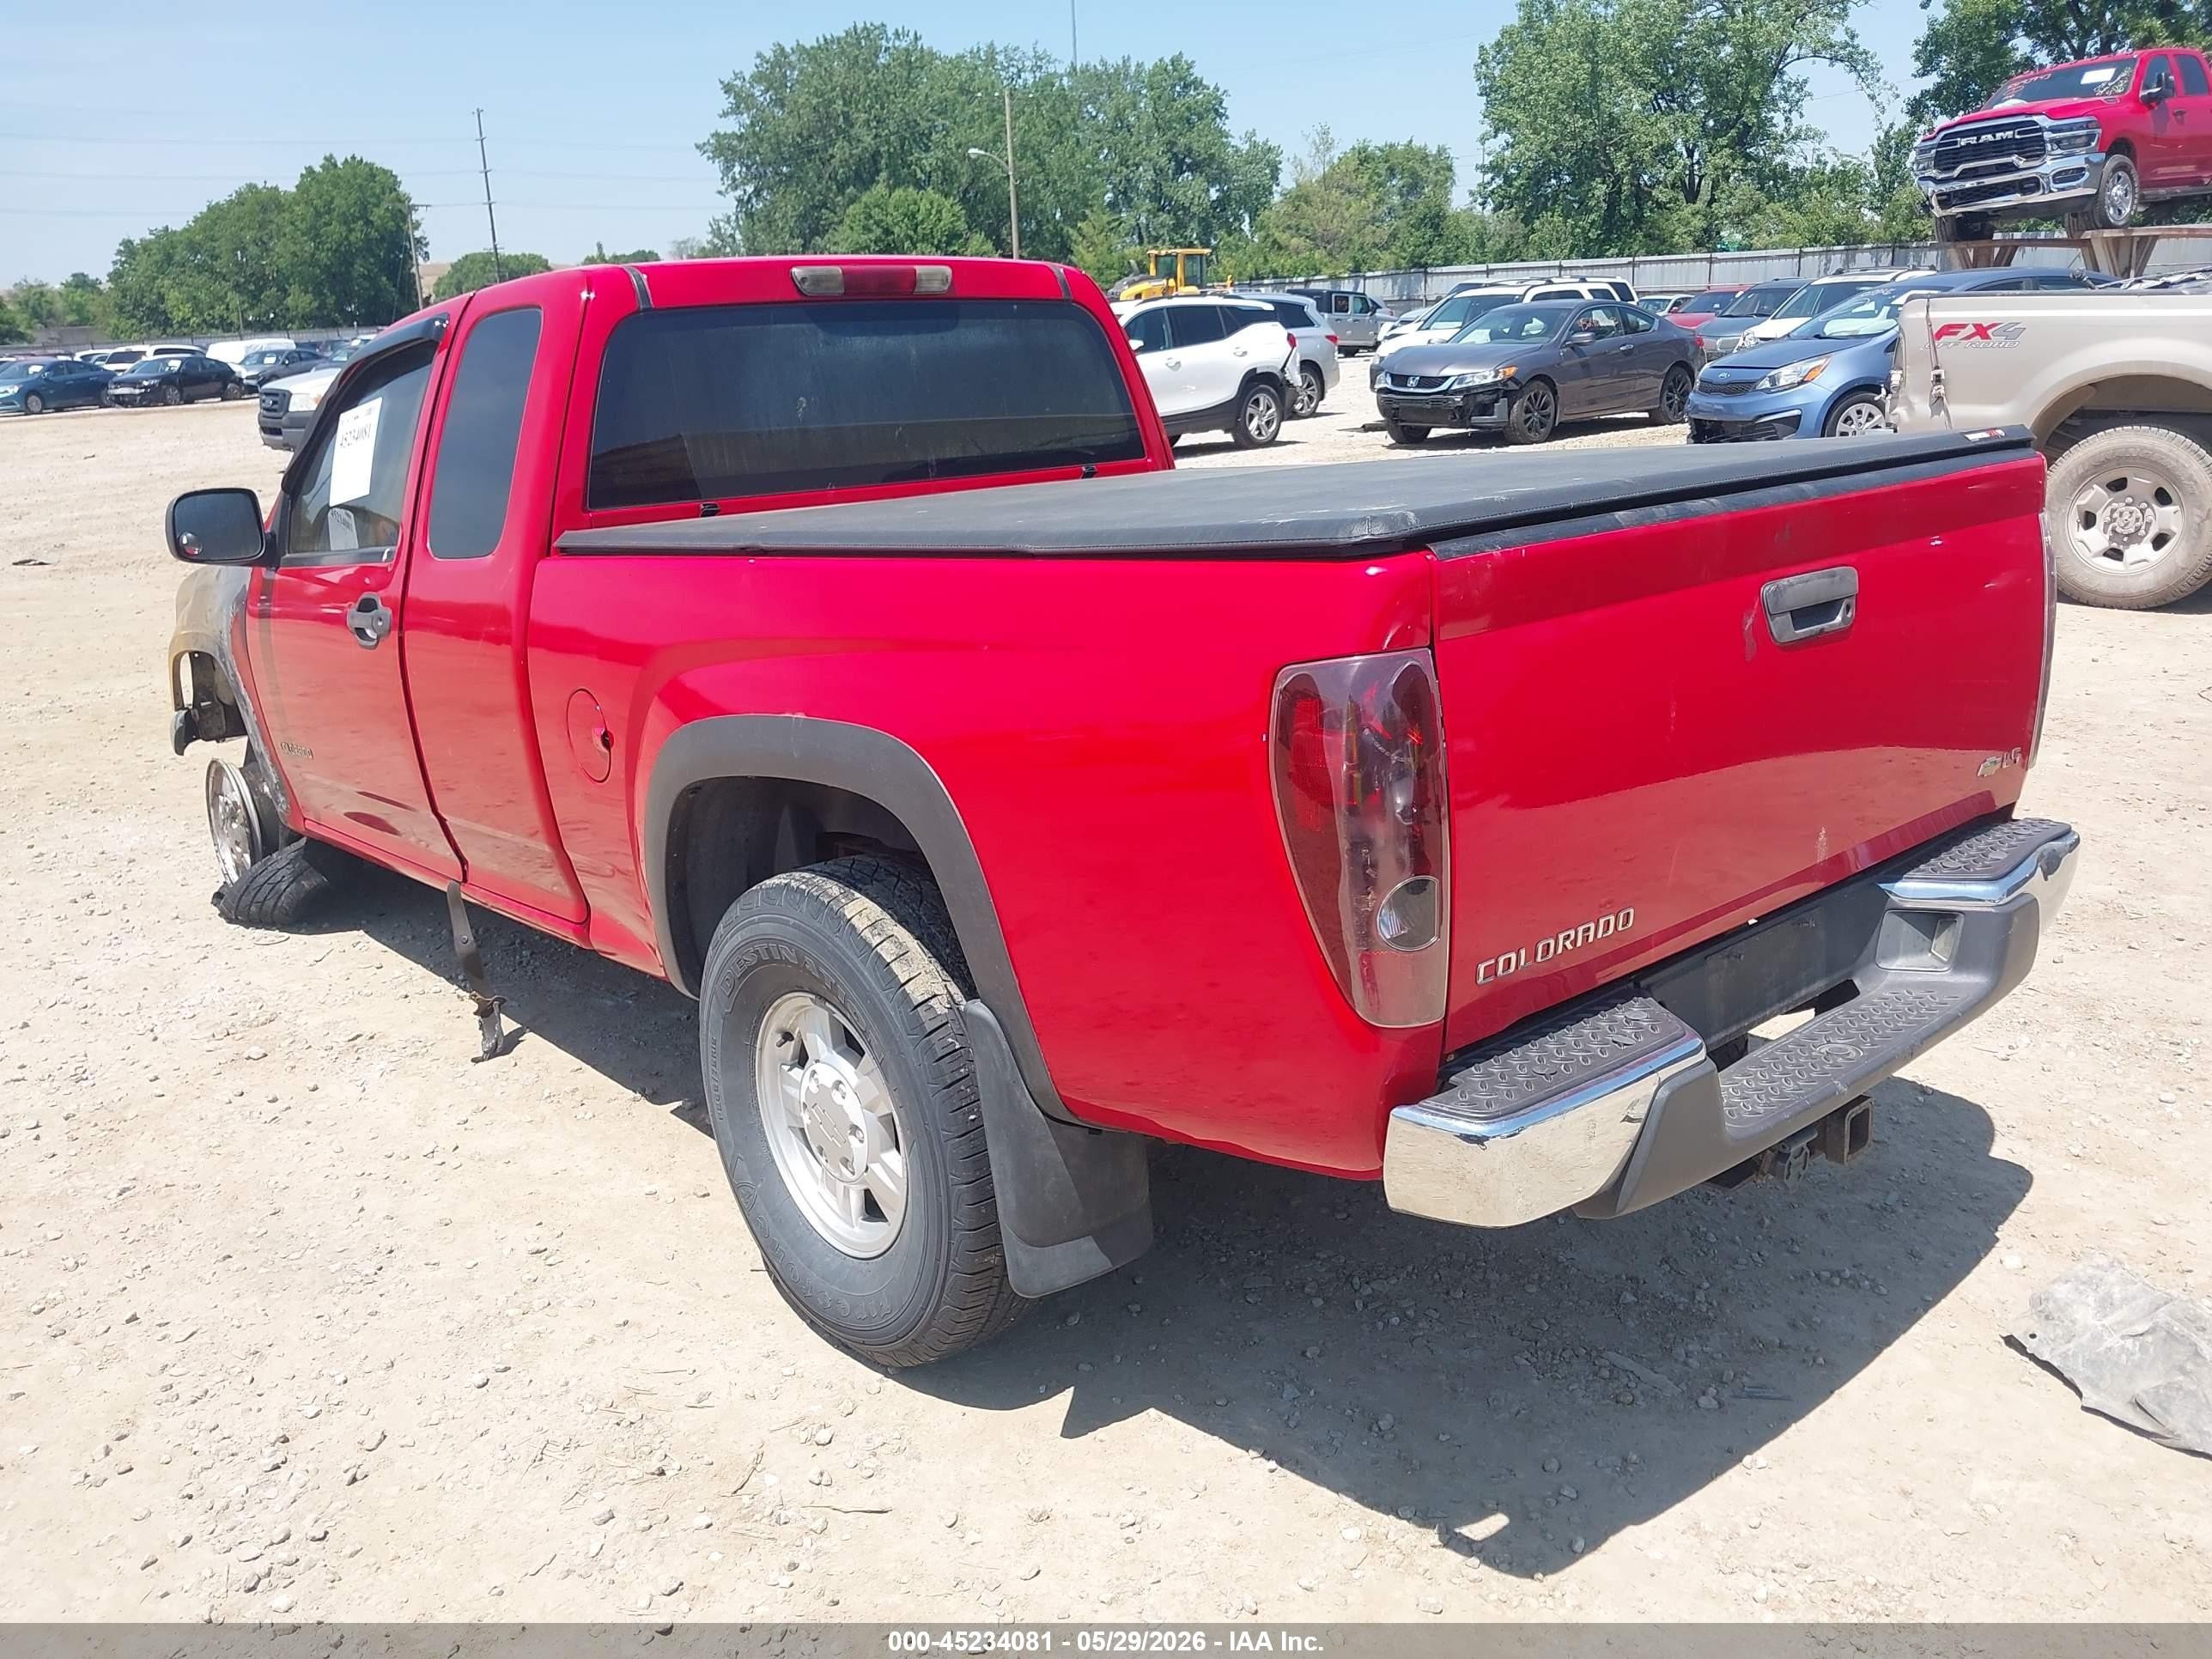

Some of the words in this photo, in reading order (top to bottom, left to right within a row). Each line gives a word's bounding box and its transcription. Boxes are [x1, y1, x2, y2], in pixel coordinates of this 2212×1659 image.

[1960, 130, 2014, 146] RAM
[1934, 322, 2027, 341] FX4
[1965, 341, 2021, 349] ROAD
[1476, 907, 1635, 985] COLORADO
[720, 943, 885, 1066] DESTINATION
